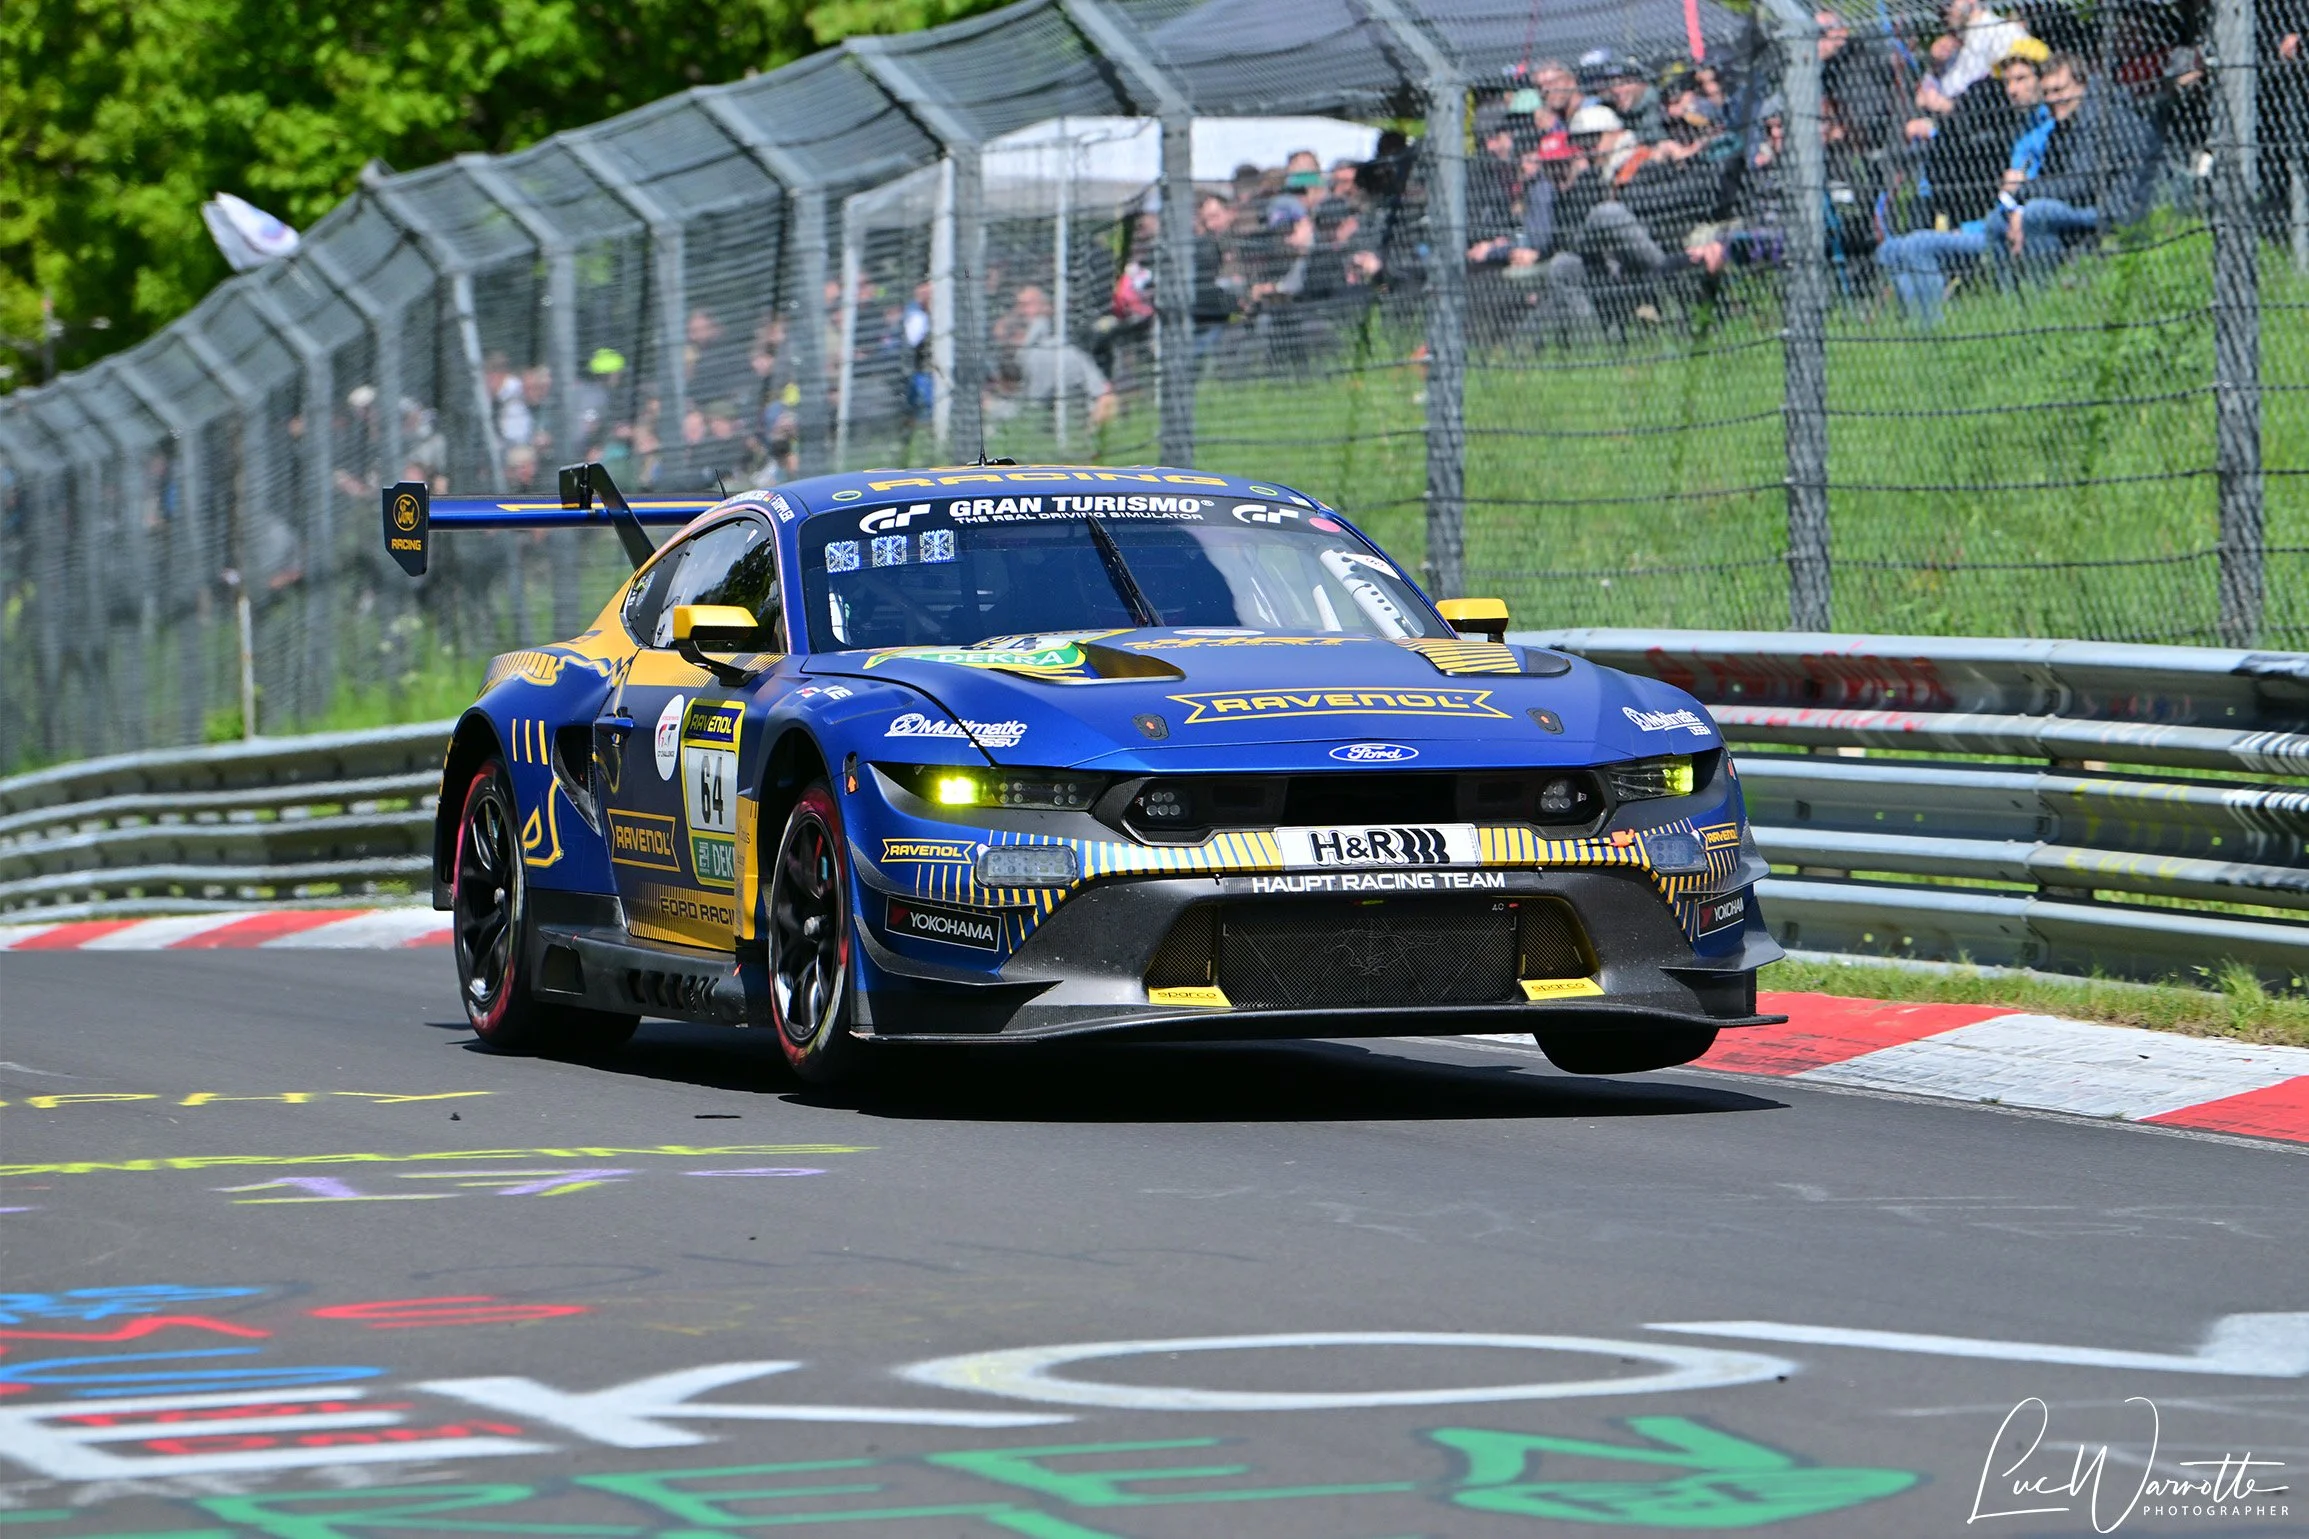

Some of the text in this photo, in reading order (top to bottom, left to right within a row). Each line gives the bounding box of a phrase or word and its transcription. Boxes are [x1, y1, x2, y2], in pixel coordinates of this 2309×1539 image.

[868, 473, 1229, 491] RACING
[949, 497, 1042, 517] GRAN
[954, 512, 1204, 524] THE REAL DRIVING SIMULATOR
[391, 538, 422, 551] RACING
[936, 651, 1066, 665] DEKRA
[1211, 693, 1471, 713] RAVENOL
[689, 714, 733, 734] RAVENOL
[918, 717, 1028, 736] Multimatic
[1346, 744, 1403, 761] Ford
[701, 755, 724, 825] 64
[615, 825, 671, 856] RAVENOL
[711, 843, 735, 878] DEK
[889, 844, 963, 858] RAVENOL
[1251, 872, 1506, 893] HAUPT RACING TEAM
[660, 898, 698, 919] FORD
[909, 911, 994, 941] YOKOHAMA
[1157, 991, 1217, 999] sparco
[1531, 982, 1587, 993] sparco
[0, 1090, 494, 1109] PHY
